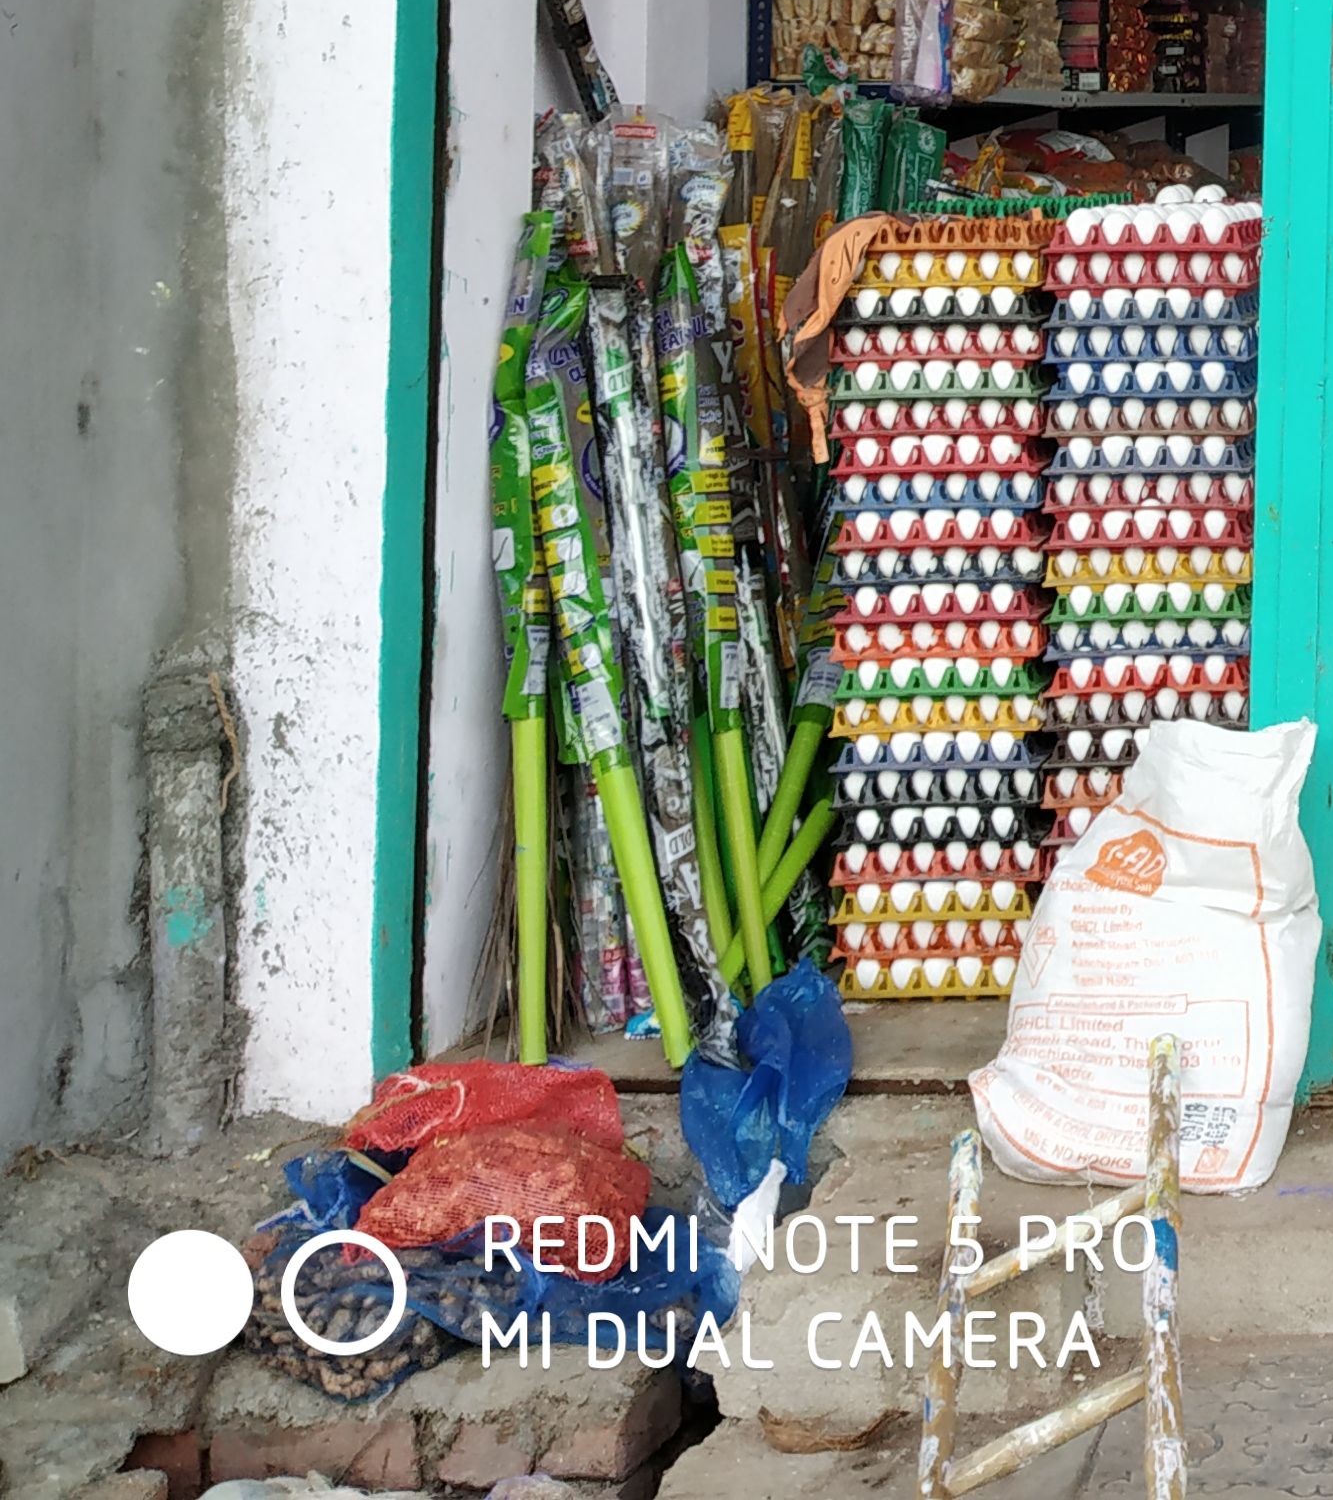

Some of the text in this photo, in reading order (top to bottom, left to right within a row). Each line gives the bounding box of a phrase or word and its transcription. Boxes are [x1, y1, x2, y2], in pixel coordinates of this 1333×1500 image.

[1014, 1016, 1124, 1032] GHCL Limited
[1023, 1127, 1134, 1170] USE NO HOOKS
